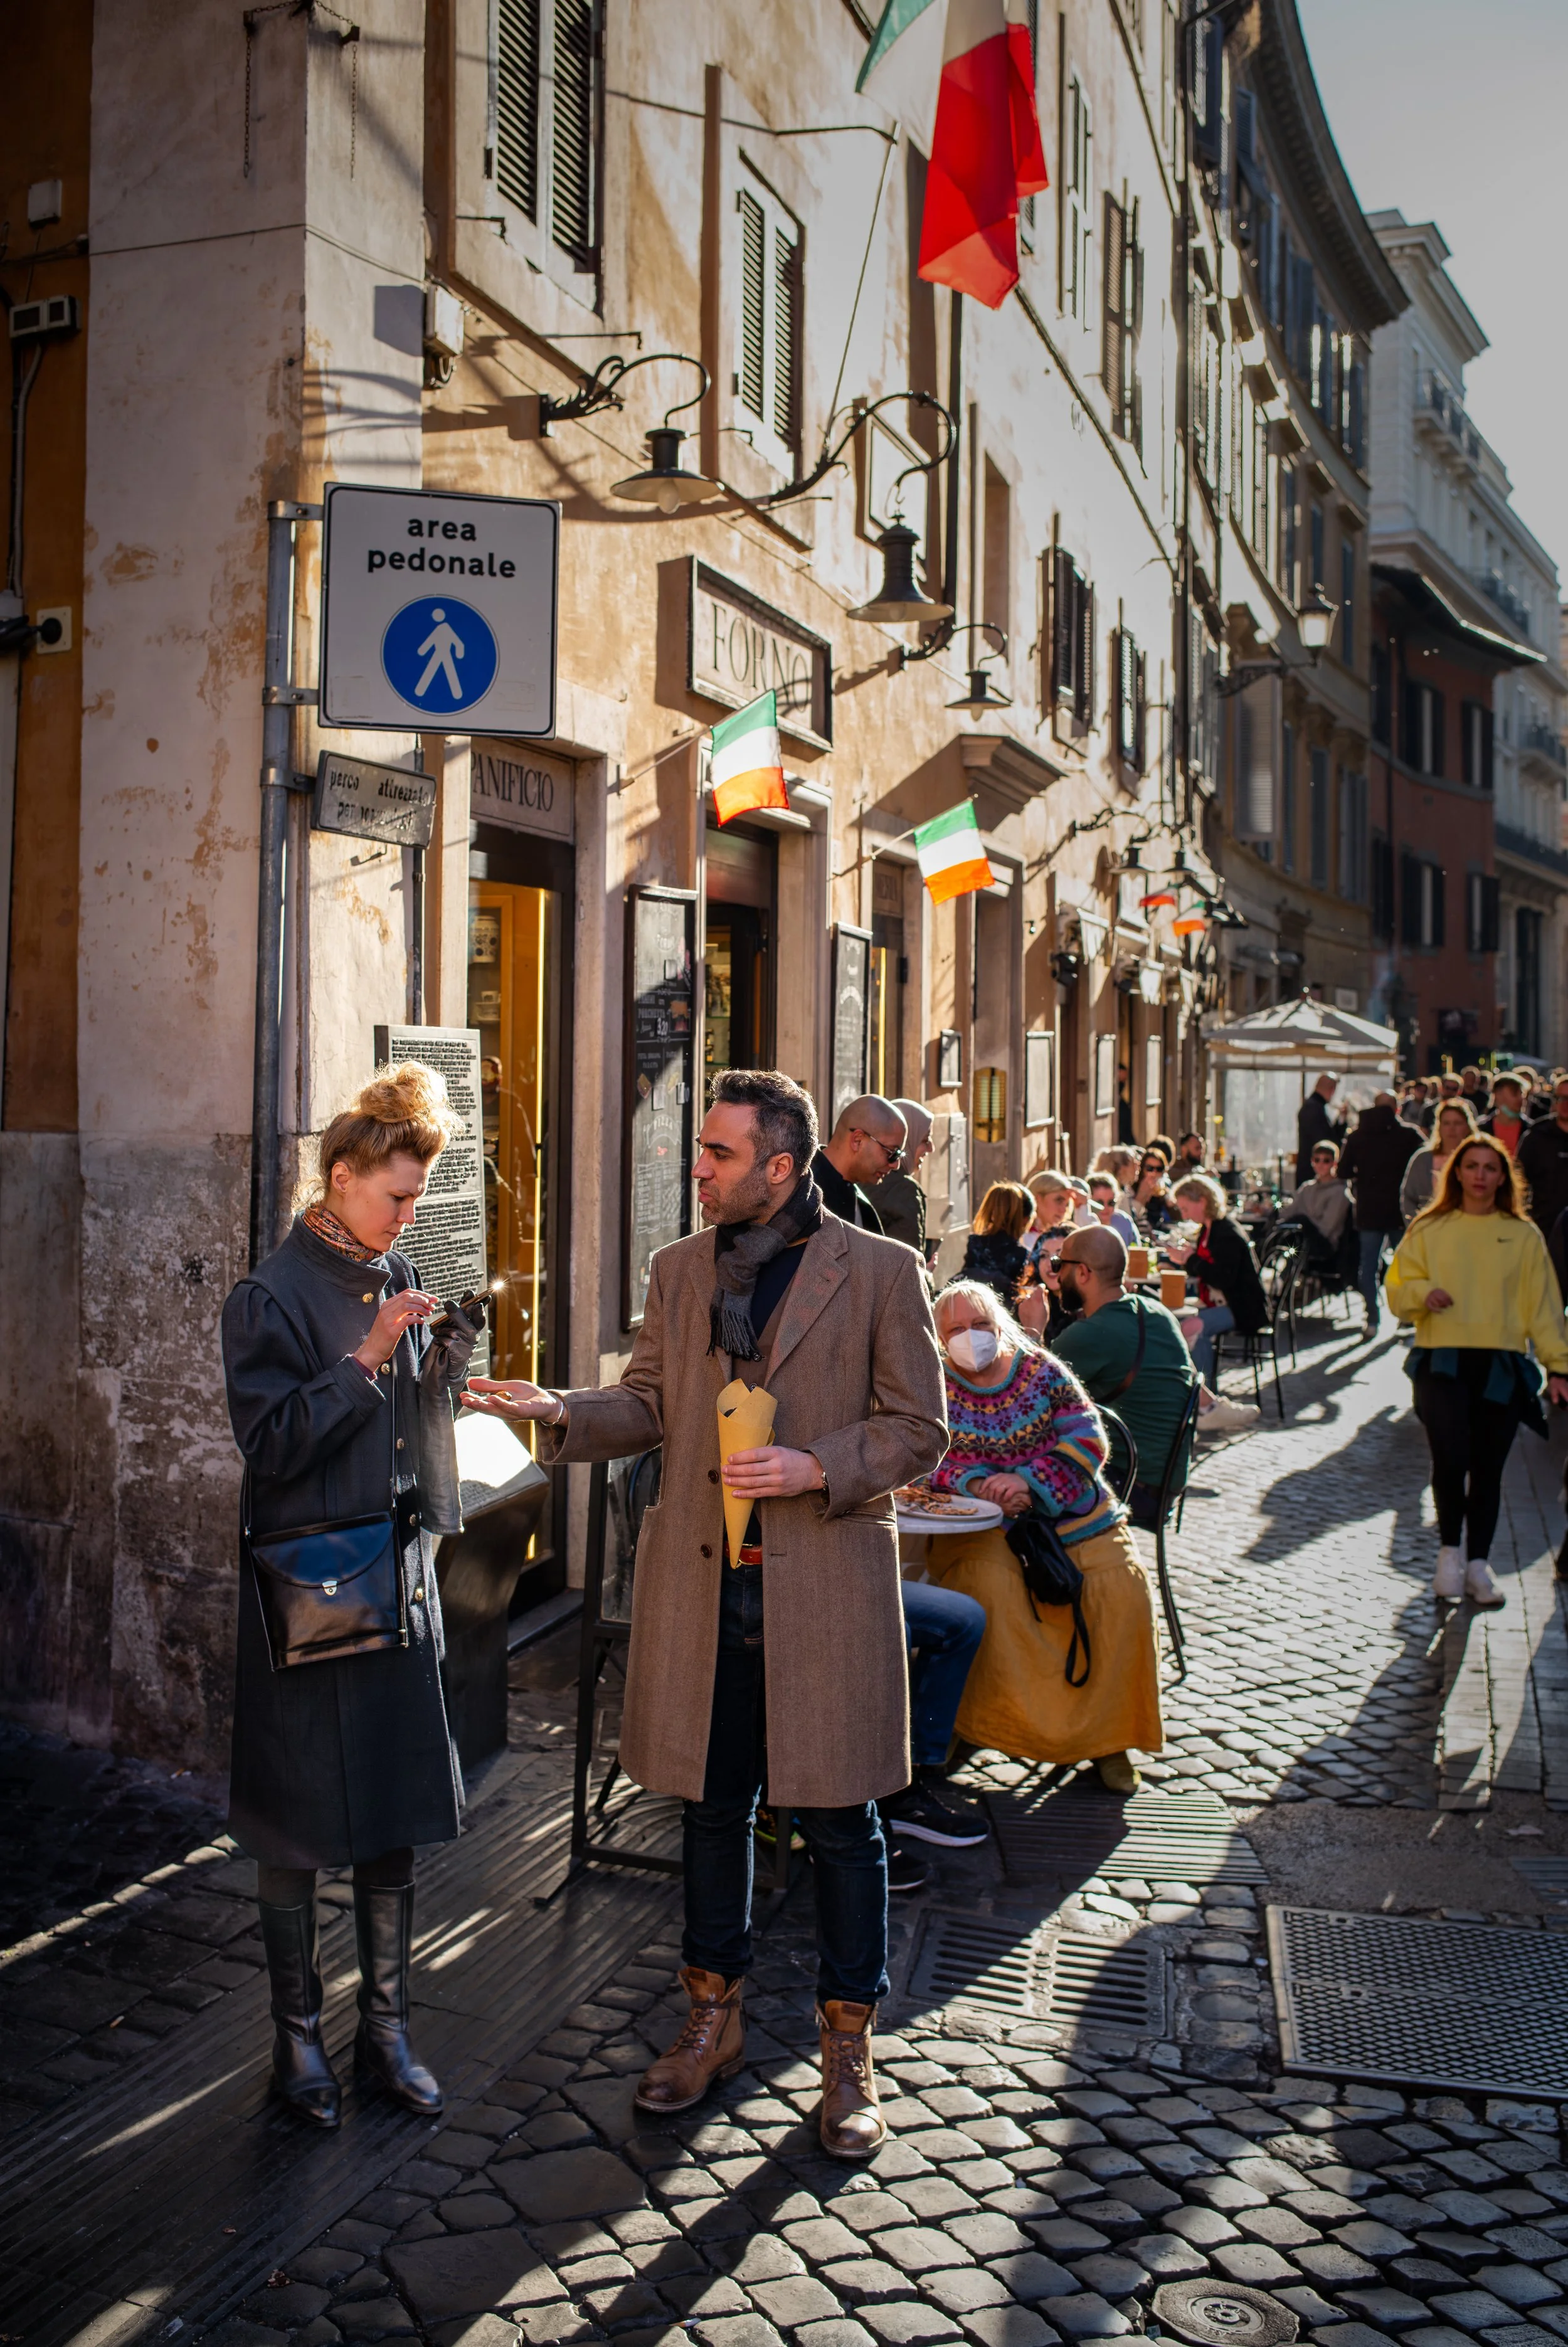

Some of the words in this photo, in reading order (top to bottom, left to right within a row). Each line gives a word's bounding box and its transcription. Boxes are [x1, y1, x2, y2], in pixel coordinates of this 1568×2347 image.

[407, 517, 477, 542] area
[367, 547, 516, 578] pedonale
[712, 602, 809, 713] FORNO
[653, 1115, 673, 1131] PIZZA
